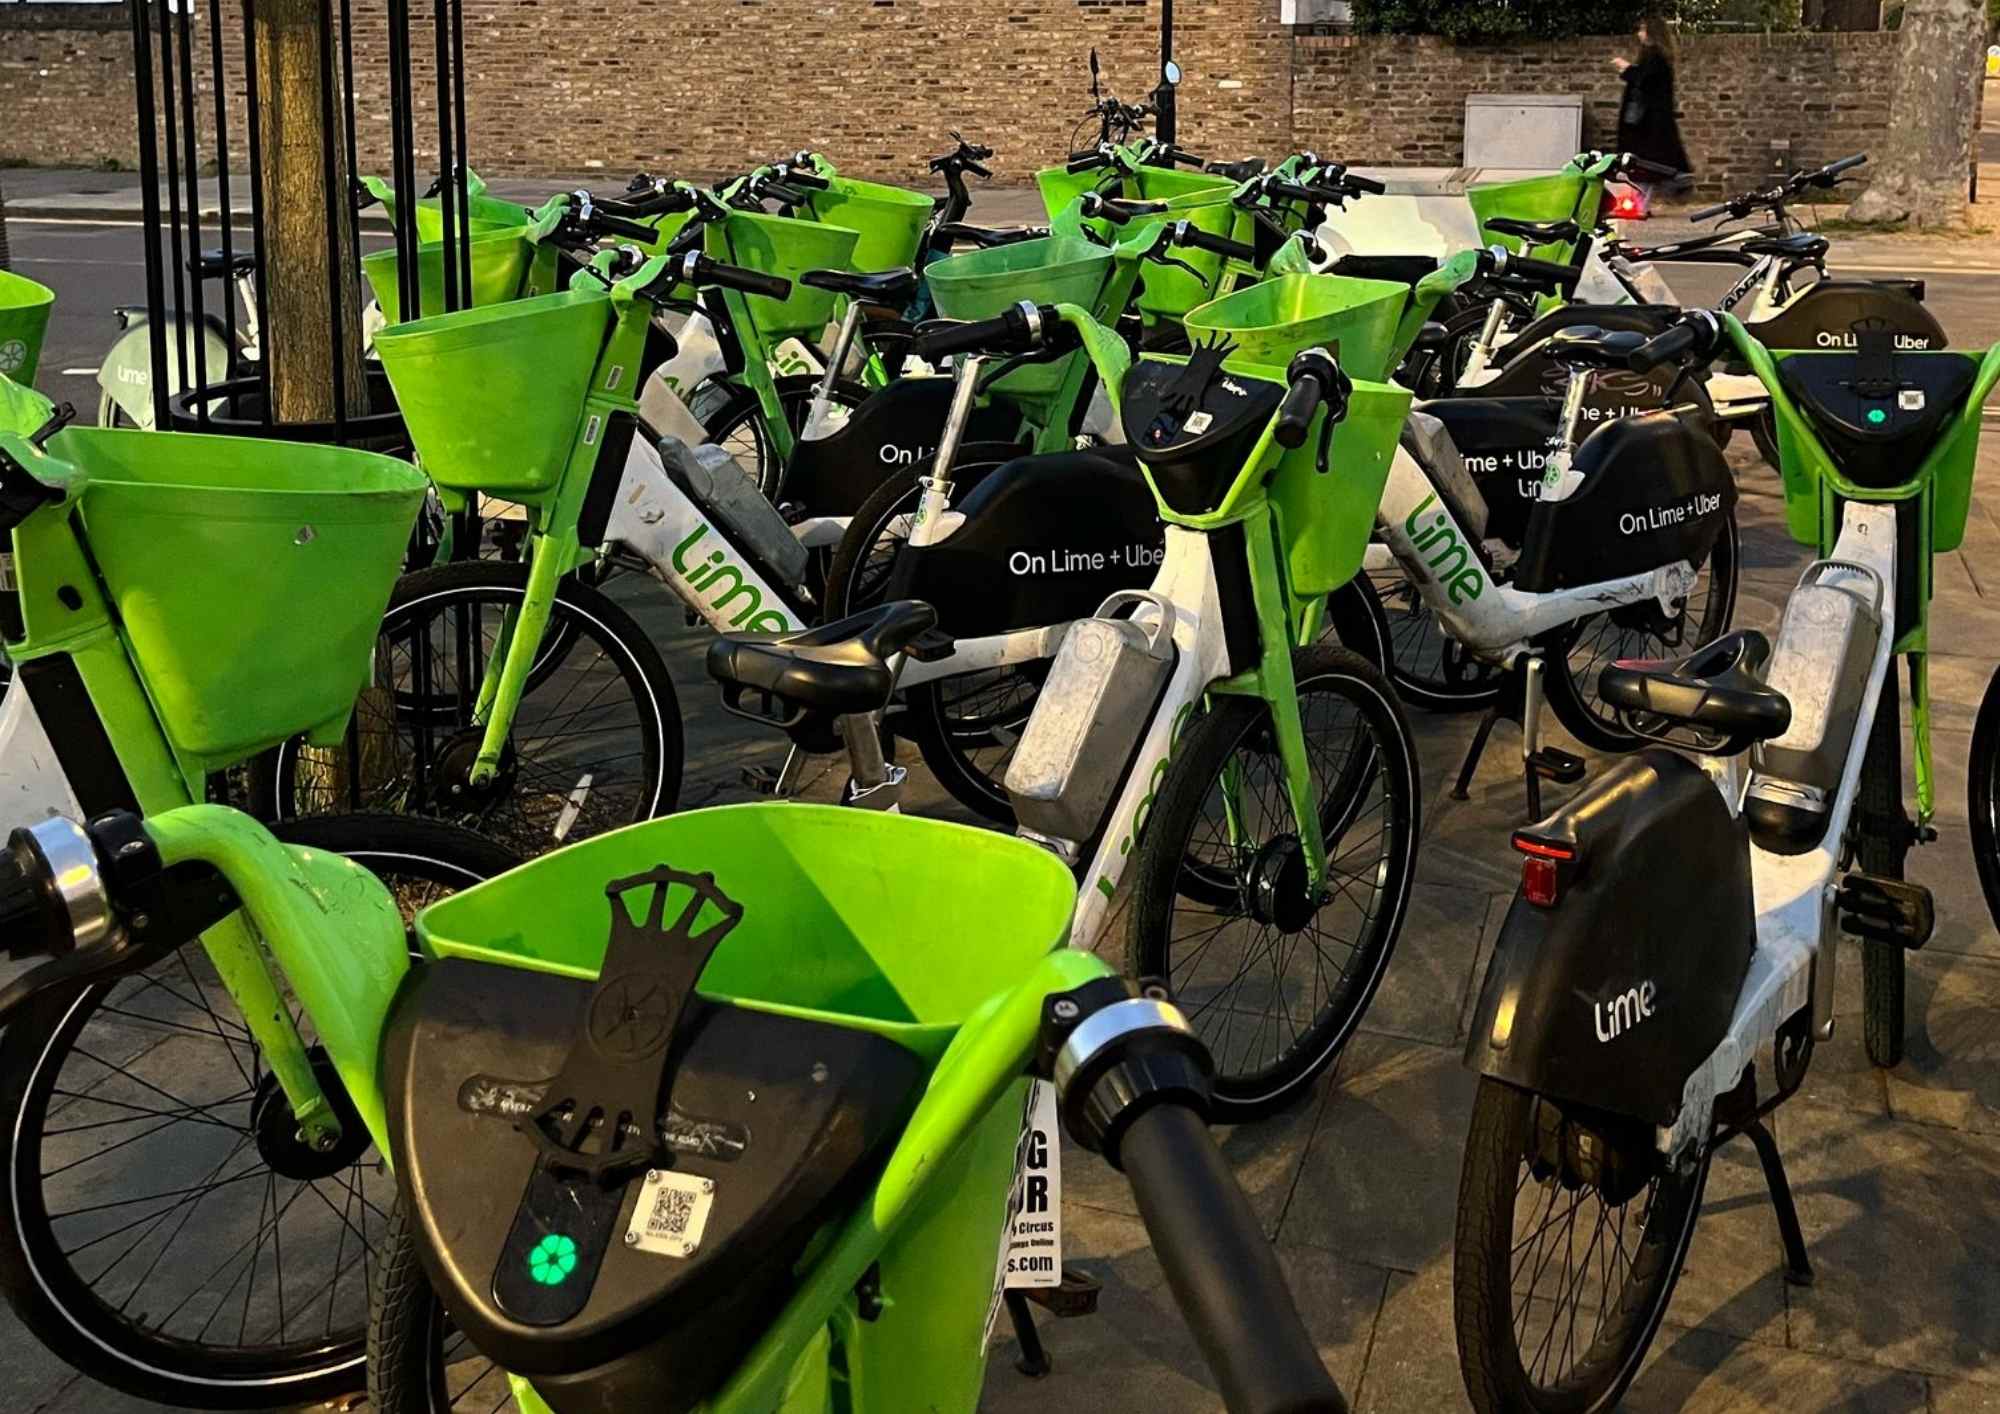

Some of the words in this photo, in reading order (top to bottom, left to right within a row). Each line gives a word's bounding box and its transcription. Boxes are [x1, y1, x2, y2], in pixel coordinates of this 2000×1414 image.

[1816, 331, 1841, 347] On
[1844, 332, 1858, 347] Li
[1894, 334, 1930, 349] Uber
[880, 443, 912, 464] On
[1619, 512, 1648, 535] On
[1648, 507, 1686, 529] Lime
[1687, 501, 1694, 515] +
[1694, 494, 1721, 516] Uber
[1009, 551, 1046, 575] On
[1051, 549, 1104, 572] Lime
[1109, 549, 1121, 565] +
[1126, 544, 1164, 567] Ube
[1594, 980, 1657, 1043] Lime
[1019, 1221, 1055, 1235] Circus
